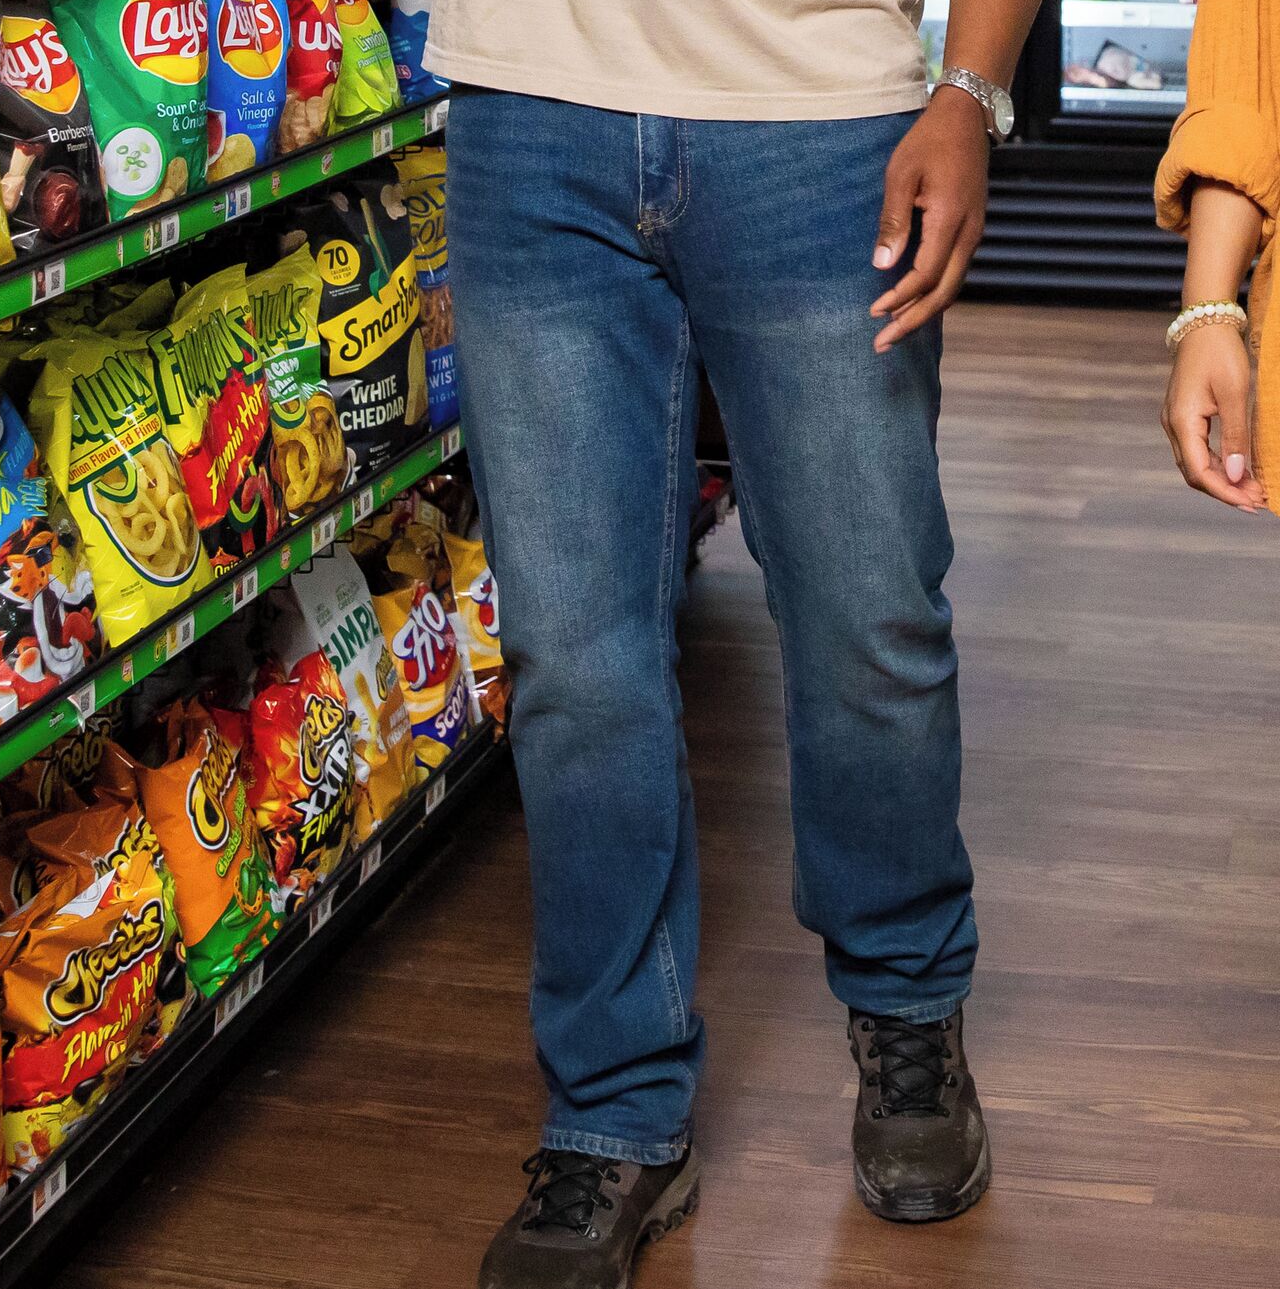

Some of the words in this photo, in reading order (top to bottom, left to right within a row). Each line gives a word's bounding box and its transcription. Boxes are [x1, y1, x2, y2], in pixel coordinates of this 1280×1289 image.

[157, 100, 191, 119] Sour
[241, 91, 263, 105] Salt
[266, 90, 275, 103] &
[323, 246, 348, 270] 70
[432, 353, 454, 371] TINY
[351, 375, 396, 405] WHITE
[240, 384, 264, 428] Hot
[339, 396, 405, 431] CHEDDAR
[90, 437, 135, 467] Flavored
[50, 909, 163, 1014] Cheetos
[132, 949, 163, 1004] Hot
